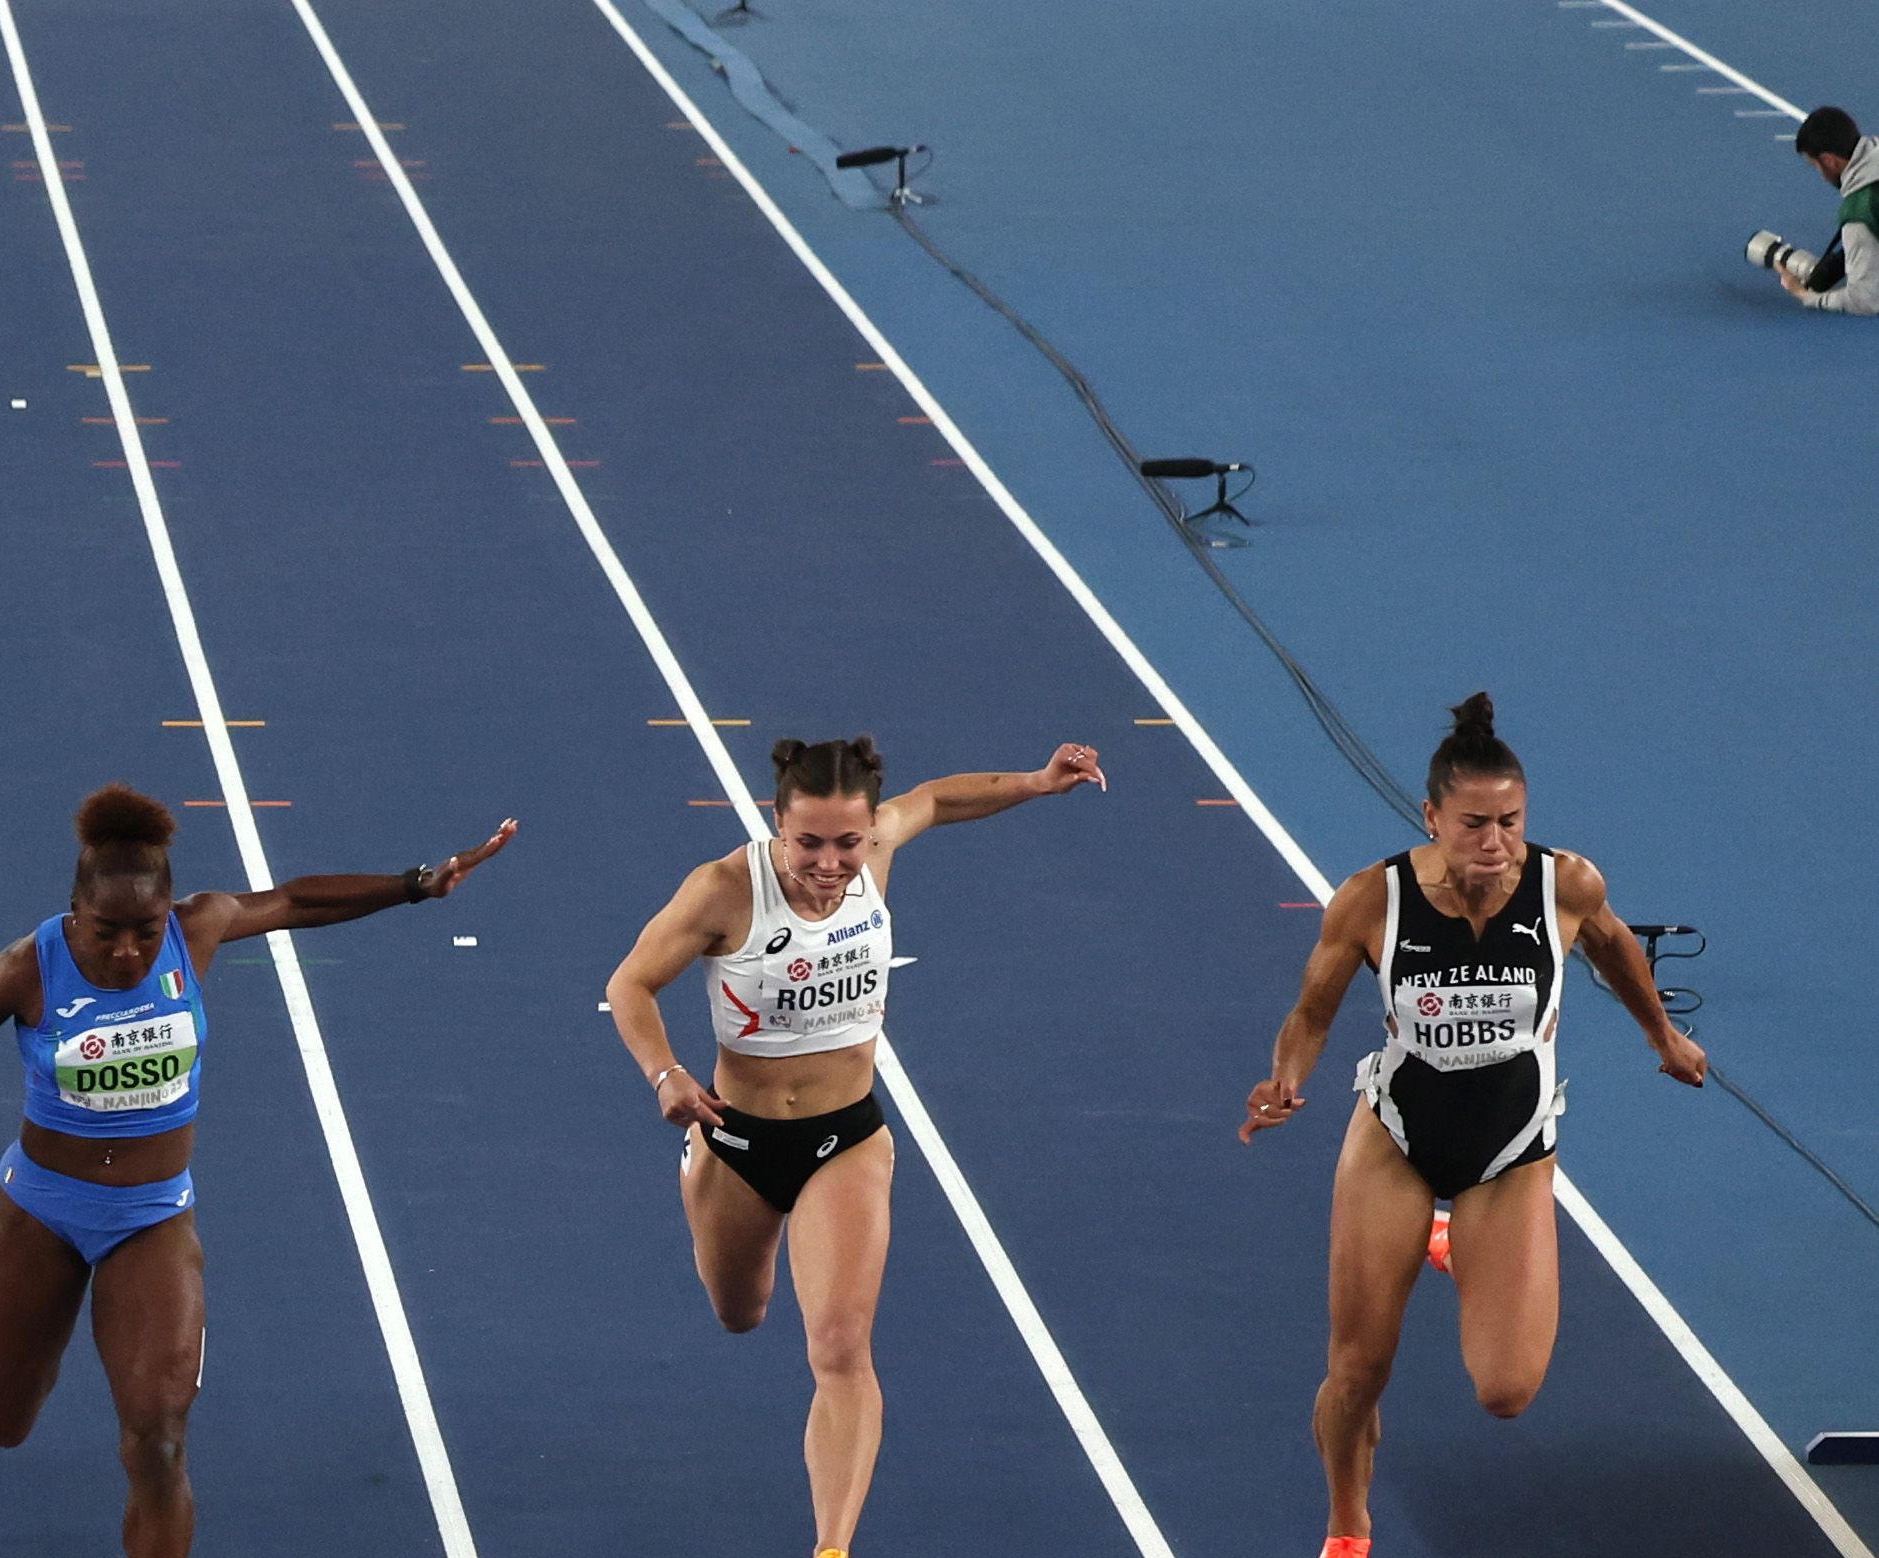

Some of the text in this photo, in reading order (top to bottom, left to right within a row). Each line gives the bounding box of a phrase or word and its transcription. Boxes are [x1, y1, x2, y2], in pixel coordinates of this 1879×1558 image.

[827, 921, 871, 946] Allianz
[817, 944, 870, 971] 南京银行
[1401, 964, 1536, 987] NEW ZEALAND
[777, 969, 878, 1011] ROSIUS
[1449, 993, 1513, 1009] 南京银行
[803, 1007, 865, 1030] NANJING
[111, 1023, 173, 1048] 南京银行
[1414, 1018, 1516, 1048] HOBBS
[1439, 1051, 1508, 1068] NANJING
[76, 1055, 179, 1092] DOSSO
[103, 1089, 168, 1110] NANJING
